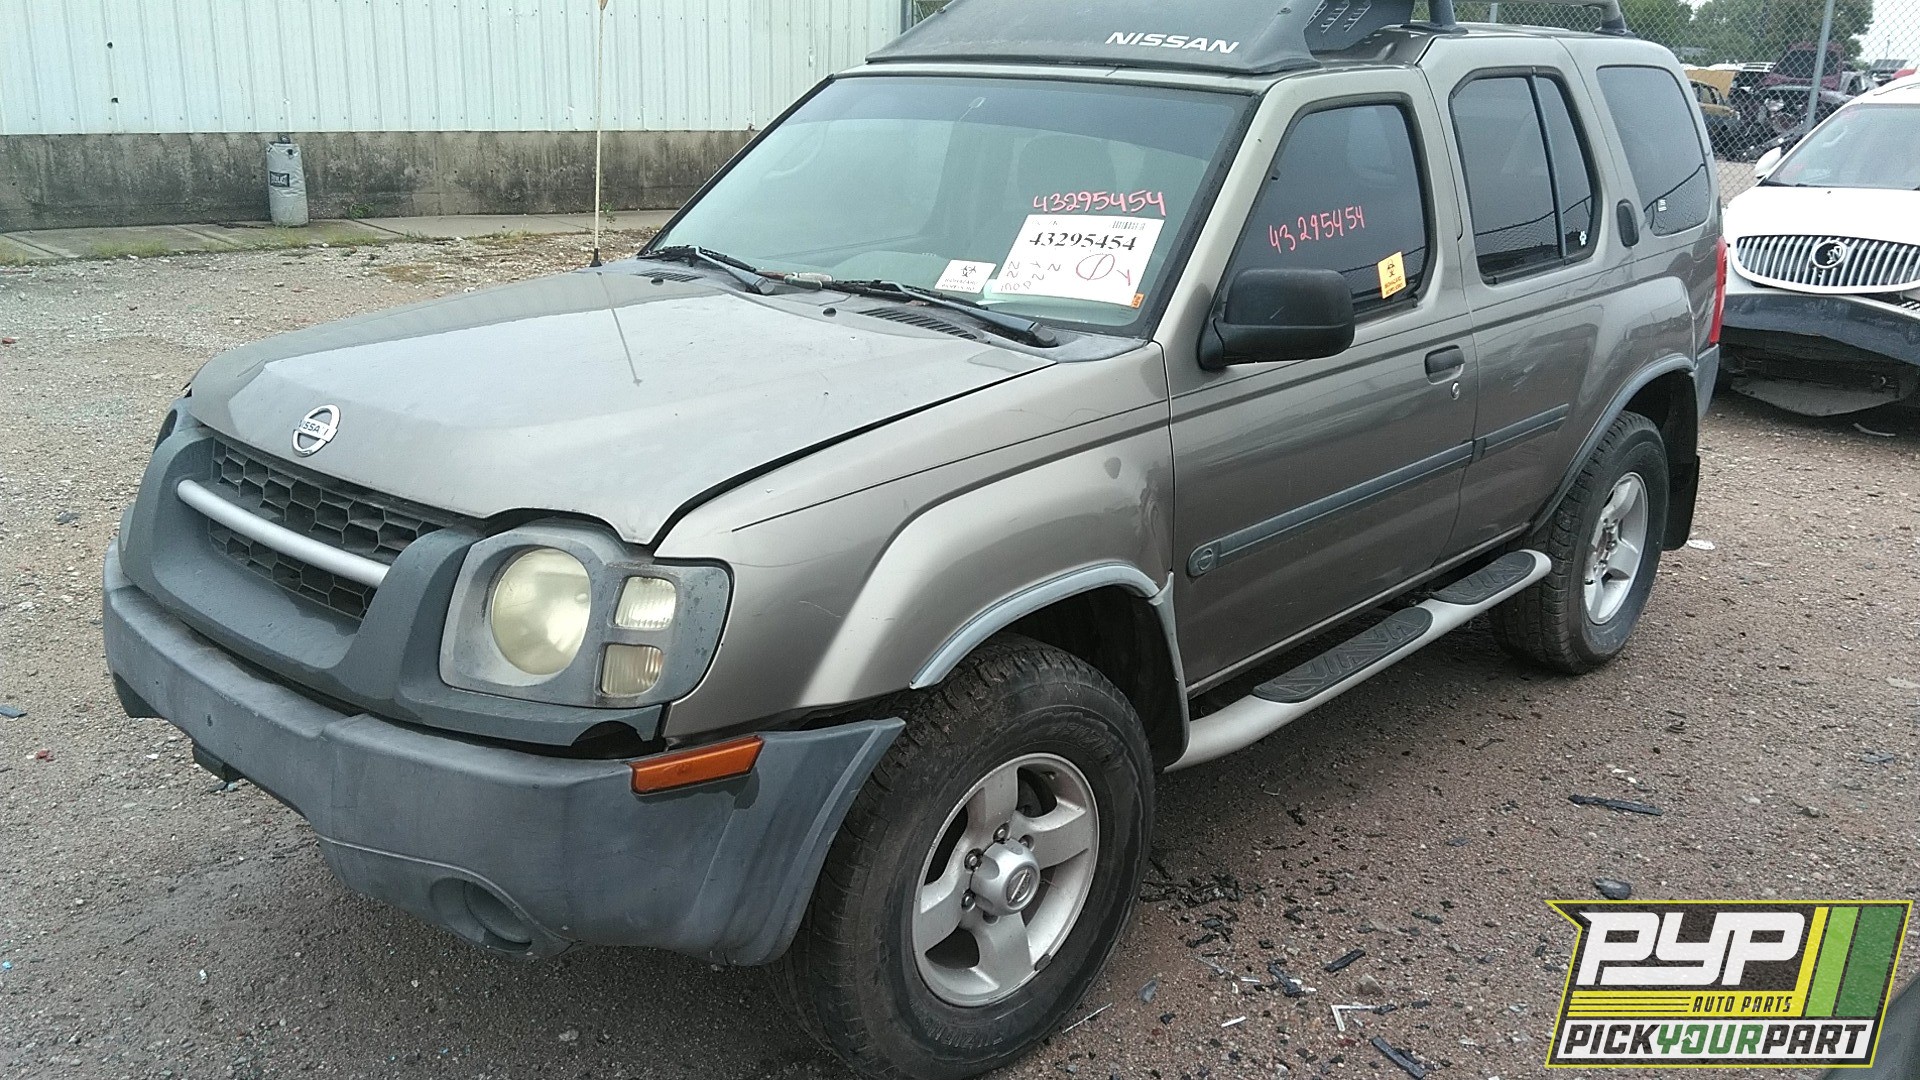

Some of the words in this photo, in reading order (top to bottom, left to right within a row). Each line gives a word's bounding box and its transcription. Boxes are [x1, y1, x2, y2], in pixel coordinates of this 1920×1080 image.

[1105, 31, 1240, 54] NISSAN
[1032, 190, 1167, 217] 43295454
[1029, 230, 1138, 251] 43295454
